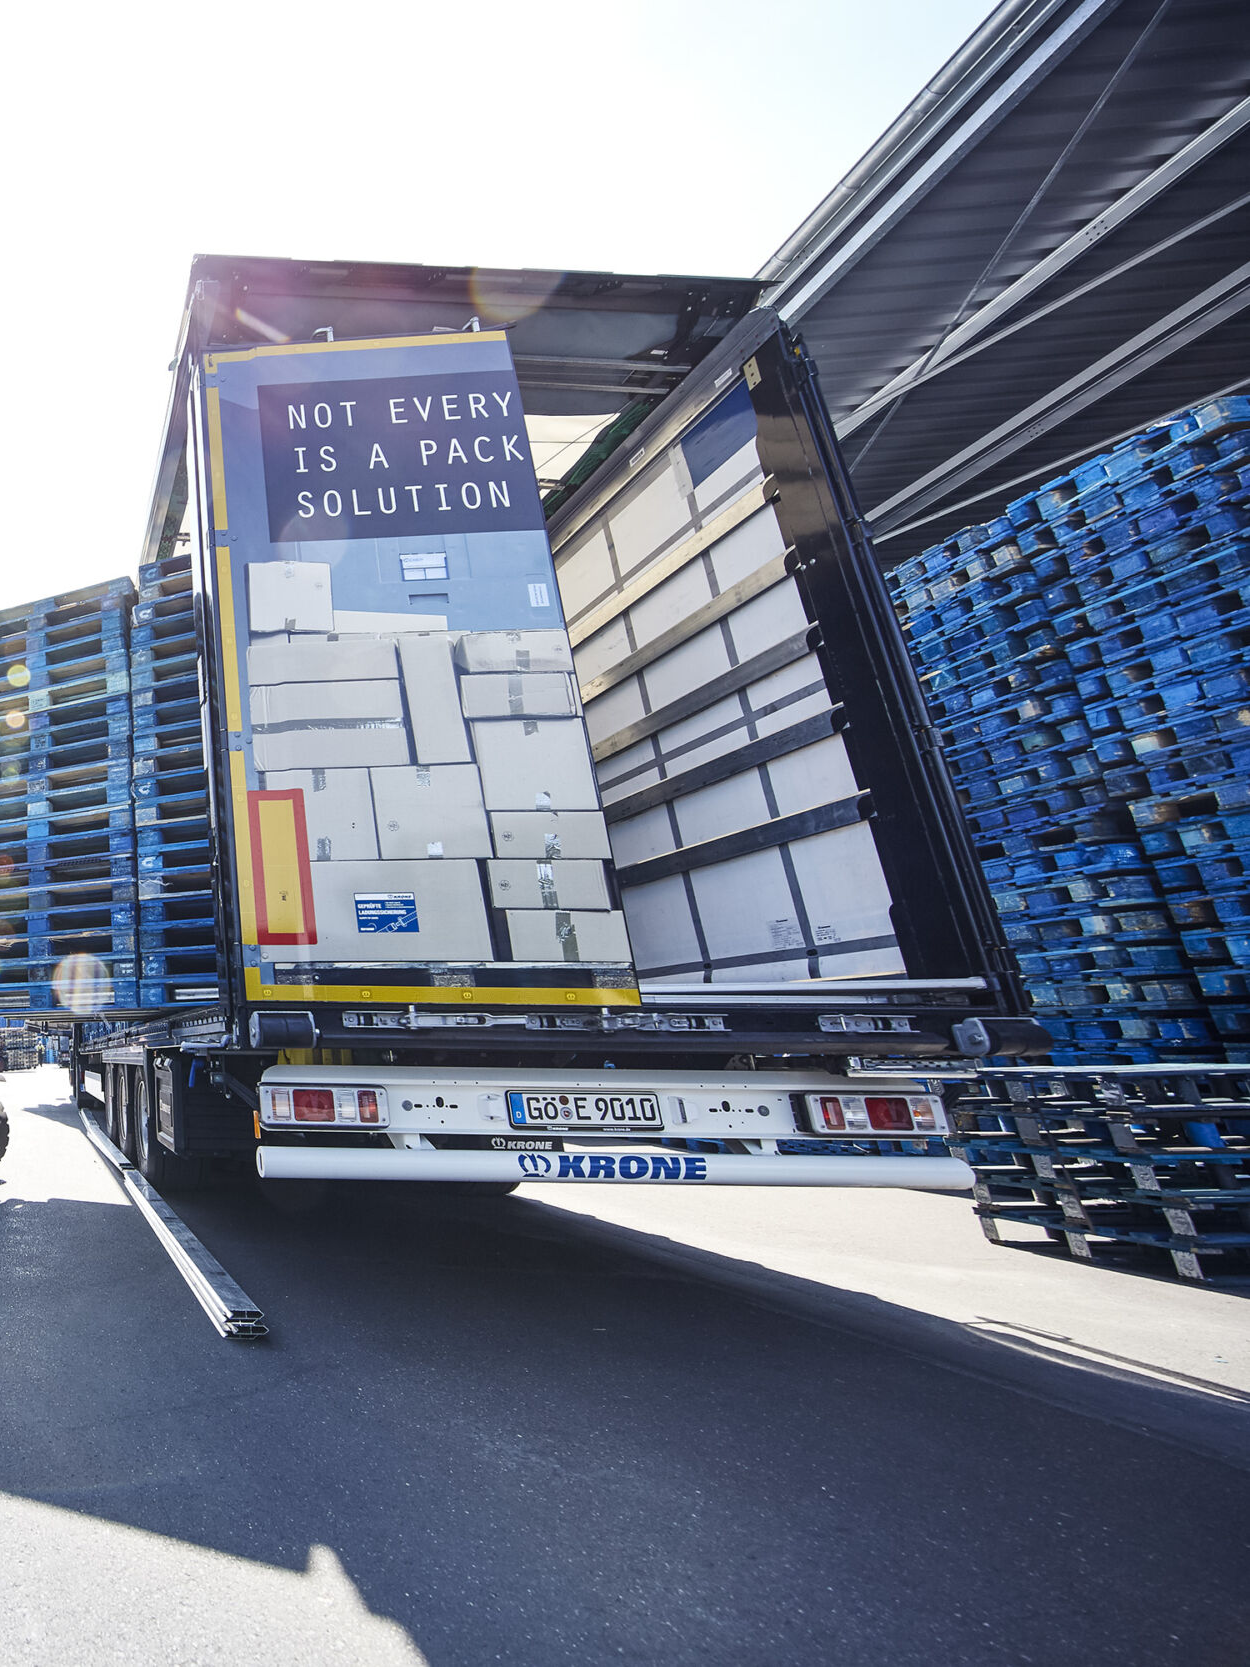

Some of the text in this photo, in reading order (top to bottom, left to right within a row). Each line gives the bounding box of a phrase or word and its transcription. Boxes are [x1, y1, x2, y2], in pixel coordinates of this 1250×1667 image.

[287, 391, 512, 429] NOT EVERY
[294, 434, 525, 473] IS A PACK
[298, 480, 511, 518] SOLUTION
[515, 1096, 657, 1121] D GÖ E 9010
[507, 1141, 553, 1150] KRONE
[557, 1155, 707, 1180] KRONE
